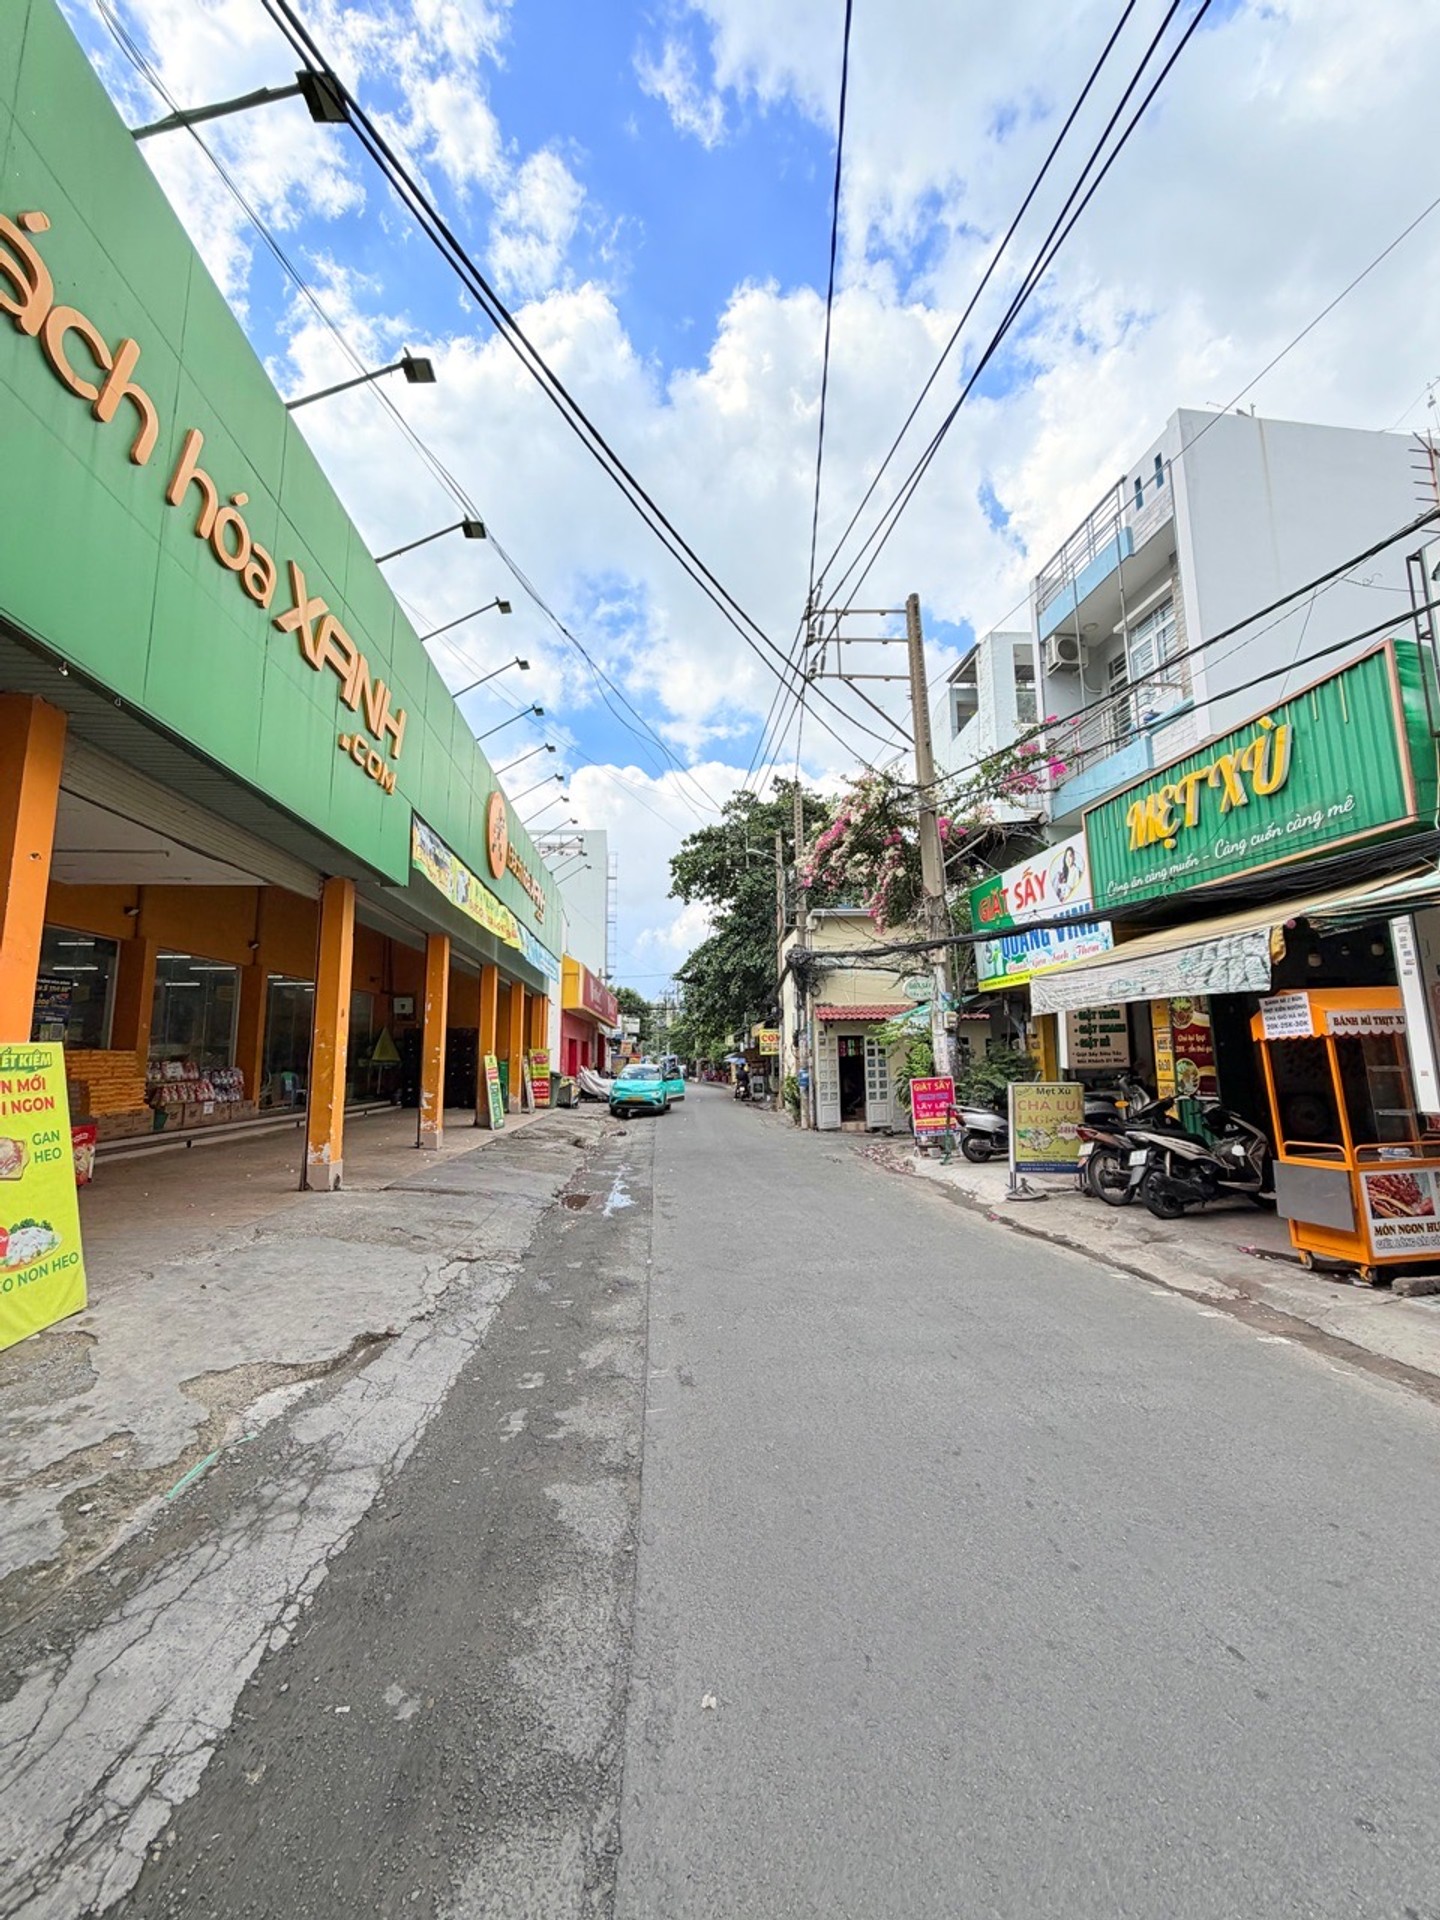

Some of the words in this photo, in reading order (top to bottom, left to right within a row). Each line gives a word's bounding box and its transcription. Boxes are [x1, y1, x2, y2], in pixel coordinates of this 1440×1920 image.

[166, 428, 277, 608] hóa
[272, 559, 407, 759] XANH
[338, 733, 397, 795] .COM
[1126, 764, 1212, 851] MẸT
[1208, 715, 1293, 814] XÙ
[1214, 838, 1247, 859] Càng
[1250, 821, 1283, 846] cuốn
[1286, 806, 1325, 832] càng
[1327, 794, 1356, 820] mê
[979, 887, 1009, 925] GIẶT
[1013, 866, 1048, 910] SẤY
[1333, 1015, 1359, 1027] BÁNH
[1360, 1014, 1372, 1026] MÌ
[1372, 1015, 1395, 1028] THỊT
[18, 1048, 52, 1071] KIỆM
[16, 1074, 46, 1092] MỚI
[11, 1096, 55, 1114] NGON
[31, 1129, 61, 1146] GAN
[33, 1146, 63, 1164] HEO
[1374, 1222, 1397, 1237] MÓN
[1397, 1222, 1425, 1236] NGON
[17, 1263, 49, 1288] NON
[52, 1251, 80, 1273] HEO
